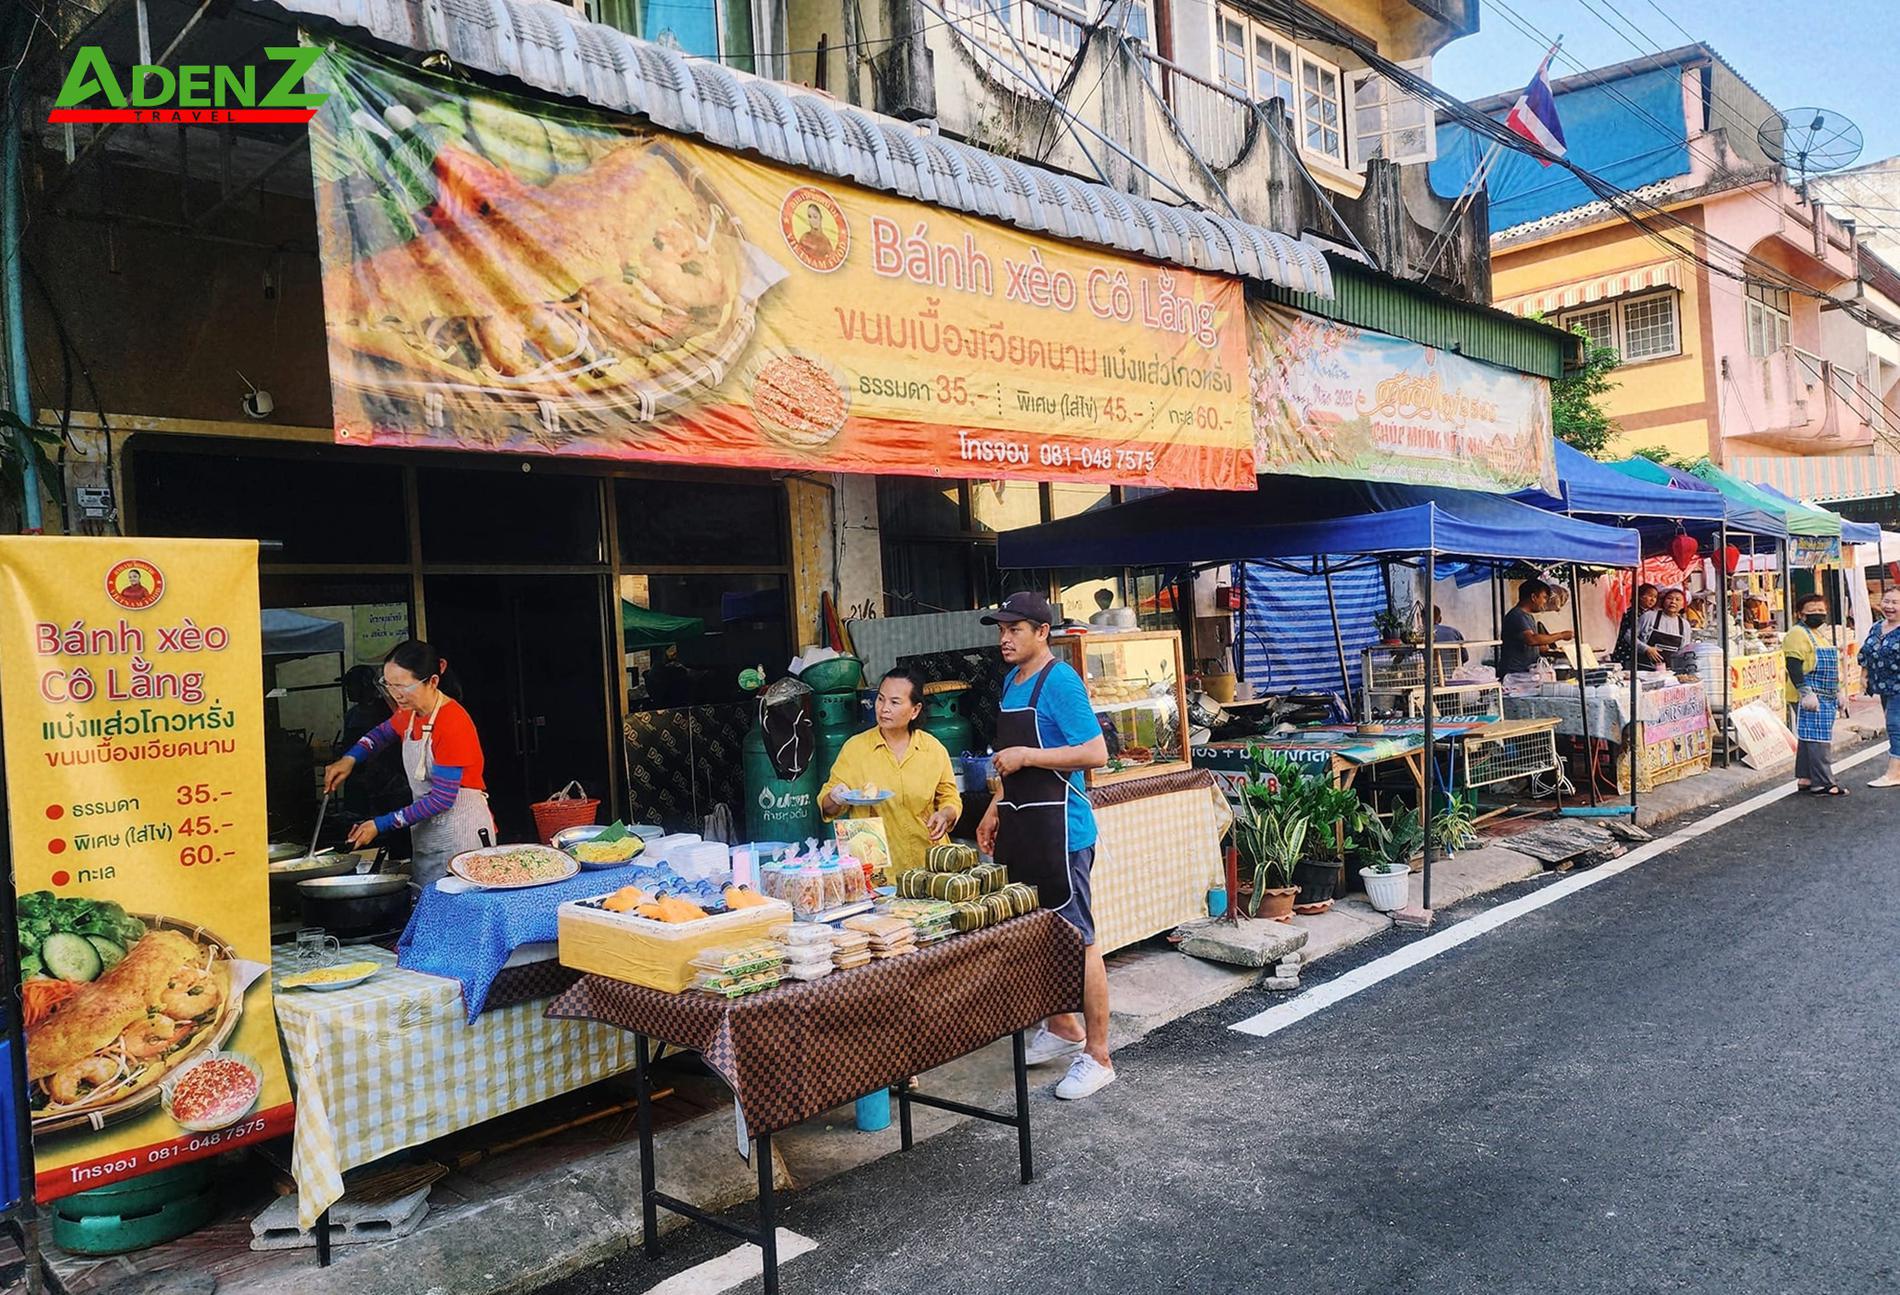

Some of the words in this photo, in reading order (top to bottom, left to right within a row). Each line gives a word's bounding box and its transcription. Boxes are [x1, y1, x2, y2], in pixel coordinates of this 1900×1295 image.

[872, 216, 993, 295] Bánh
[1004, 246, 1076, 311] xèo
[1088, 265, 1133, 321] Cô
[835, 297, 1097, 375] ขนมเบื้องเวียดนาม
[859, 376, 930, 401] ธรรมดา
[1017, 389, 1057, 415] พิเศษ
[1060, 393, 1098, 424] (ใส่ไข่)
[1168, 409, 1194, 426] ทะเล
[958, 430, 1029, 464] โทรจอง
[1040, 443, 1112, 469] 081-048
[1116, 448, 1155, 471] 7575
[35, 619, 144, 655] Bánh
[156, 618, 229, 652] xèo
[40, 667, 96, 702] Cô
[45, 737, 235, 767] ขนมเบื้องเวียดนาม
[72, 798, 139, 817] ธรรมดา
[176, 784, 232, 805] 35.-
[74, 833, 120, 851] พิเศษ
[125, 822, 173, 848] (ใส่ไข่)
[178, 816, 233, 837] 45.-
[78, 865, 116, 883] ทะเล
[180, 844, 235, 866] 60.-
[71, 1157, 137, 1183] โทรจอง
[148, 1133, 221, 1163] 081-048
[226, 1118, 265, 1140] 7575
